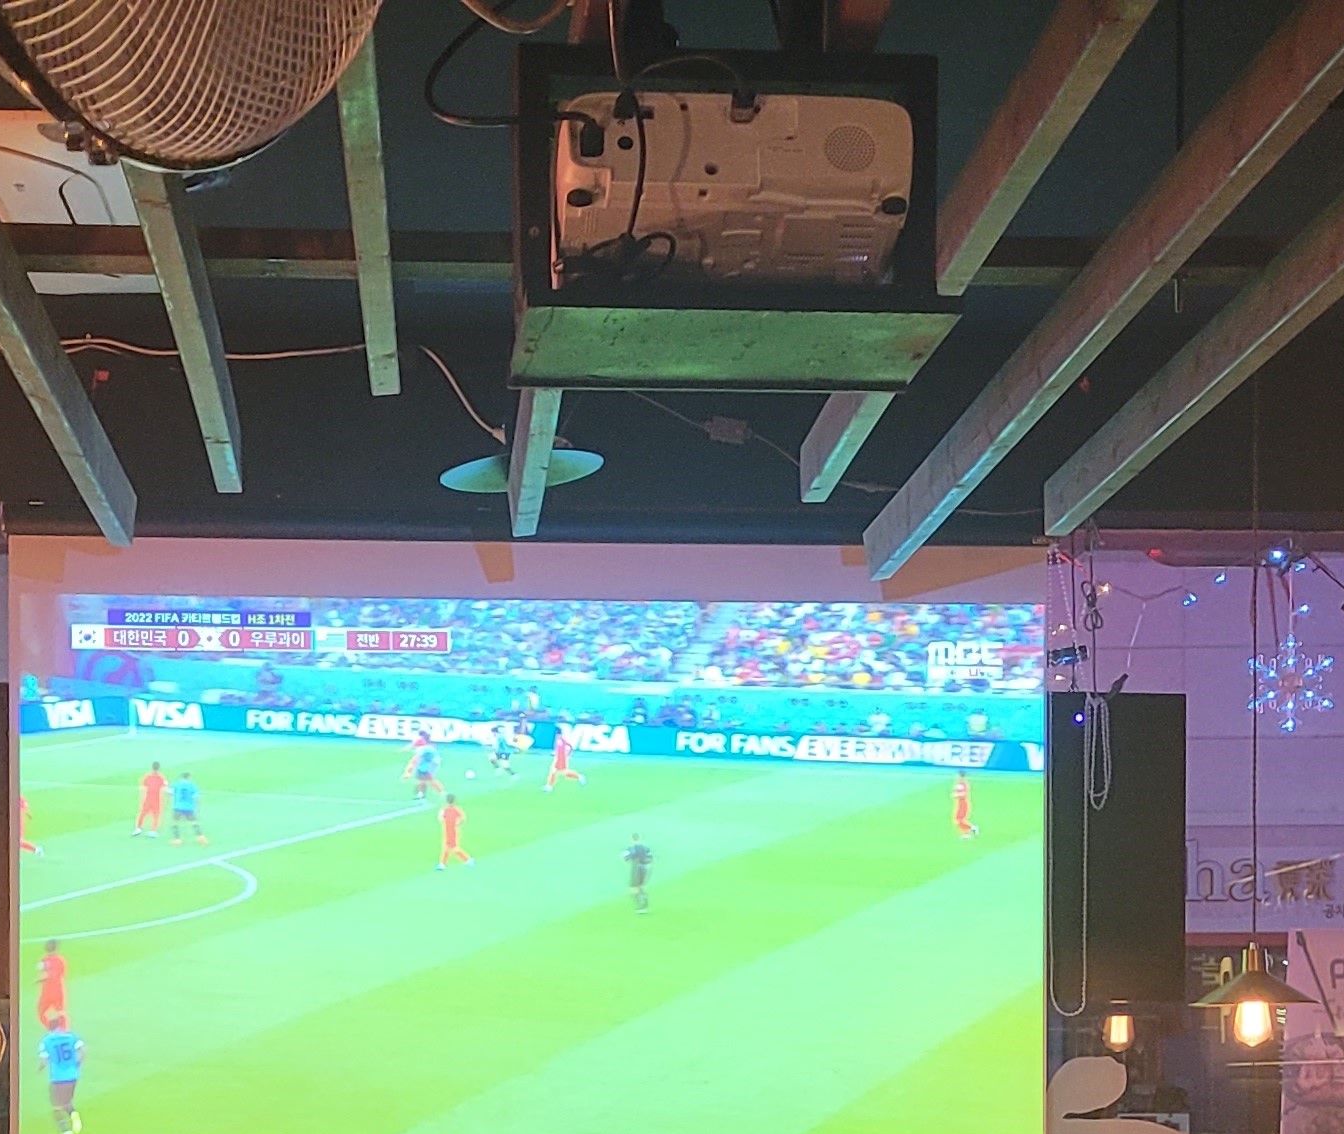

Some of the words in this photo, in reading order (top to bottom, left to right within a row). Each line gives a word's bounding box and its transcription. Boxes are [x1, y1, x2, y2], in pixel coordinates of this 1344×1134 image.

[125, 612, 152, 623] 2022
[155, 612, 179, 623] FIFA
[113, 632, 168, 646] 대한민국
[177, 631, 190, 647] 0
[228, 631, 241, 647] 0
[250, 632, 306, 648] 우루과이
[356, 633, 380, 648] 전반
[399, 633, 439, 649] 27:39
[43, 700, 95, 729] VISA
[134, 700, 204, 729] VISA
[246, 708, 295, 732] FOR
[297, 711, 358, 737] FANS
[561, 724, 631, 753] VISA
[675, 731, 727, 754] FOR
[729, 733, 795, 758] FANS
